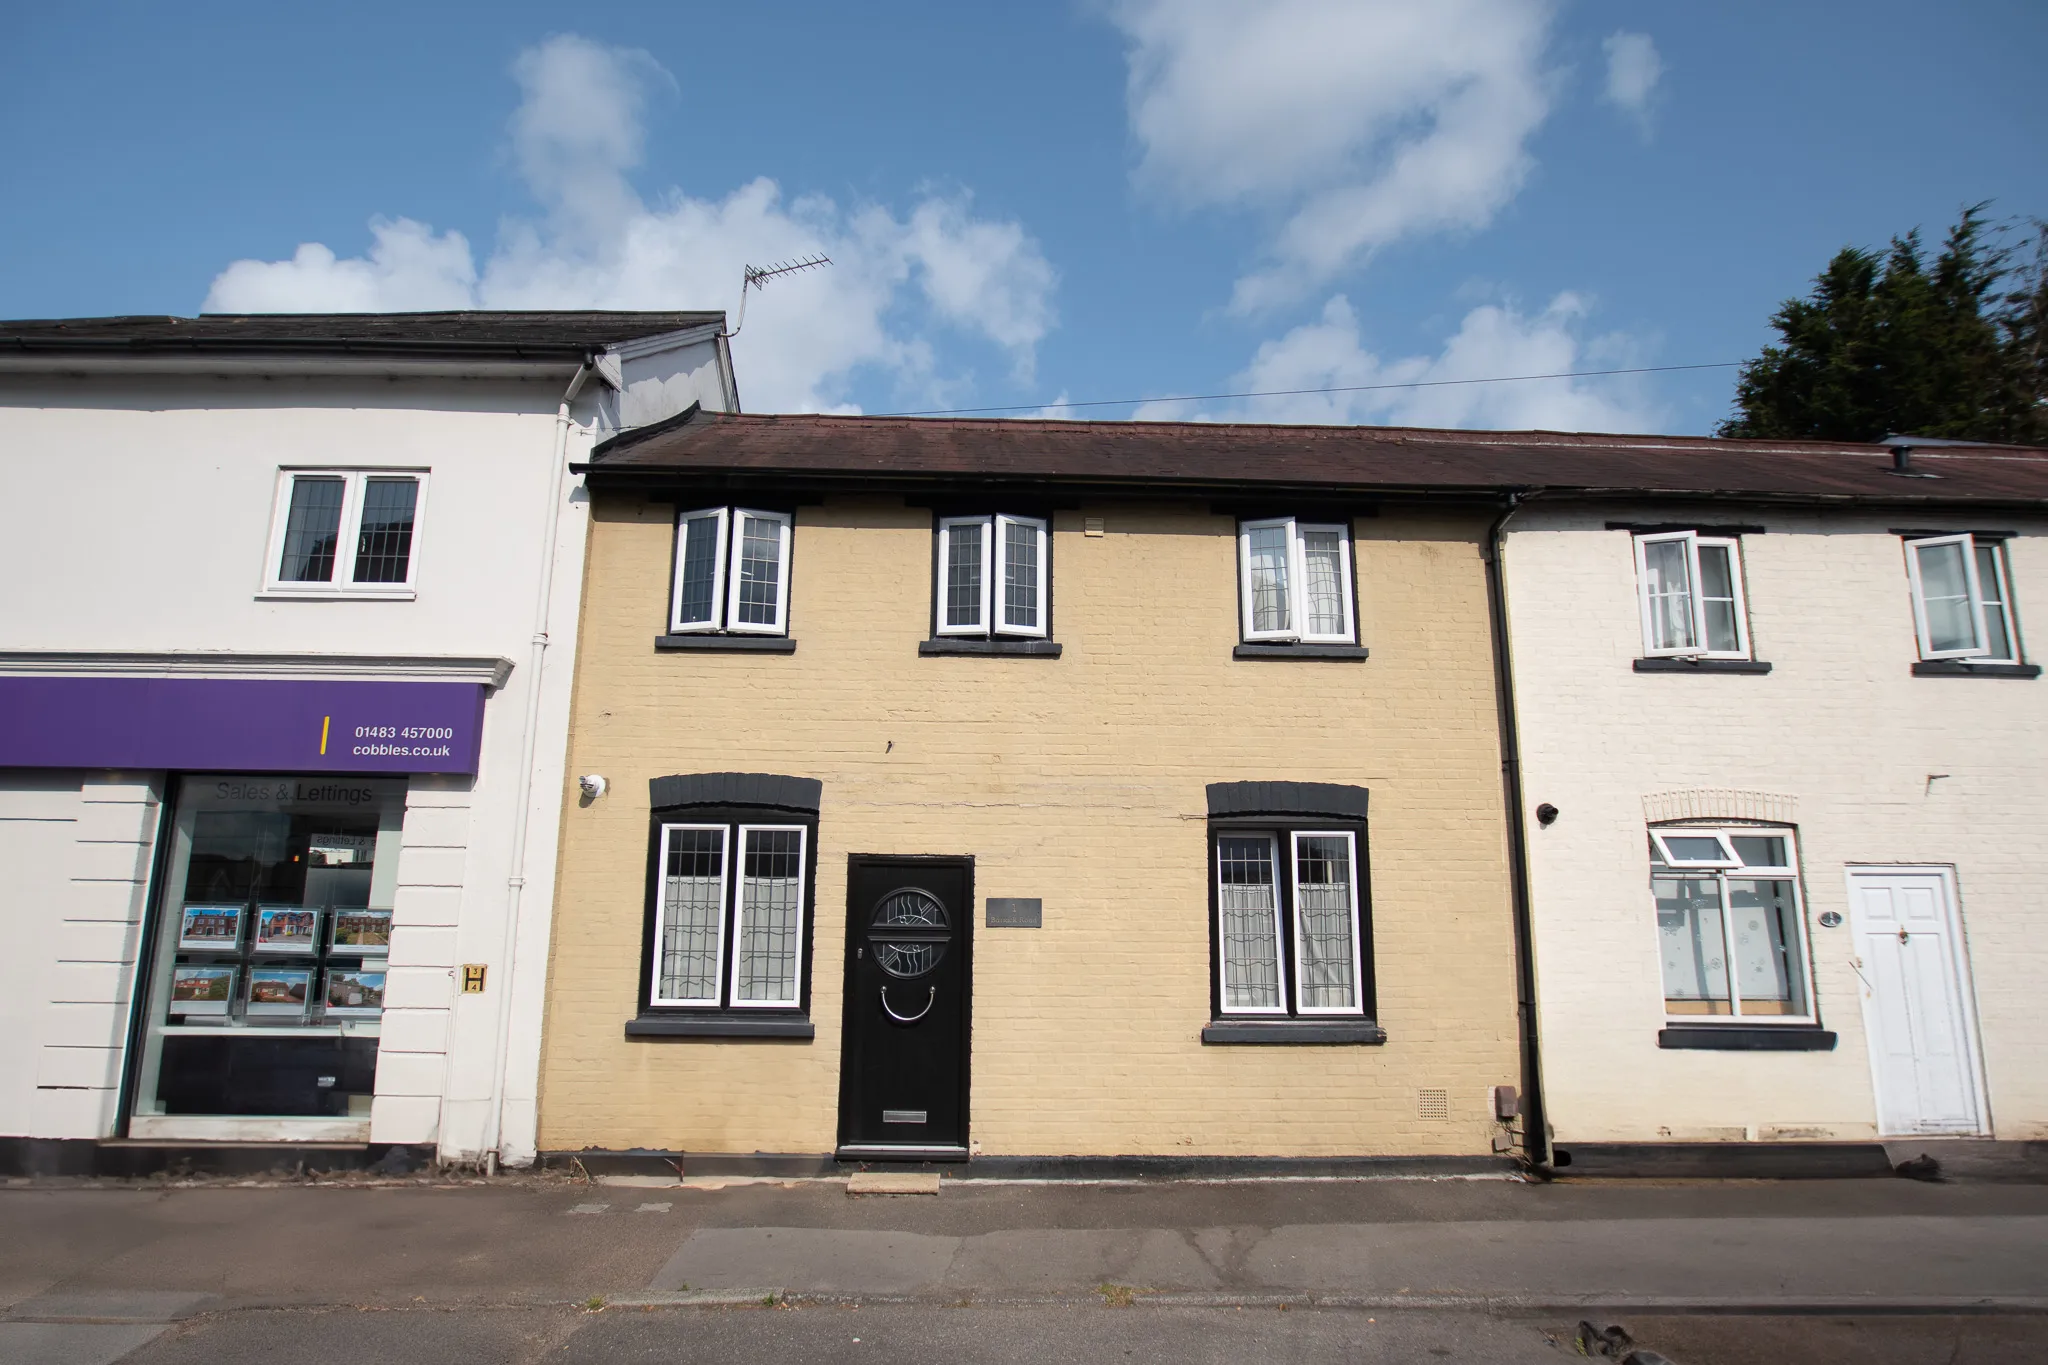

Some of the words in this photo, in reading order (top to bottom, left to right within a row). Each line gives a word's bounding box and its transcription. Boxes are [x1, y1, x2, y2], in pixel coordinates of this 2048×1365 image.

[355, 726, 396, 738] 01483
[401, 727, 453, 739] 457000
[353, 744, 450, 756] cobbles.co.uk
[215, 782, 270, 800] Sales
[276, 783, 290, 801] &
[296, 784, 373, 805] Lettings
[465, 967, 485, 991] H
